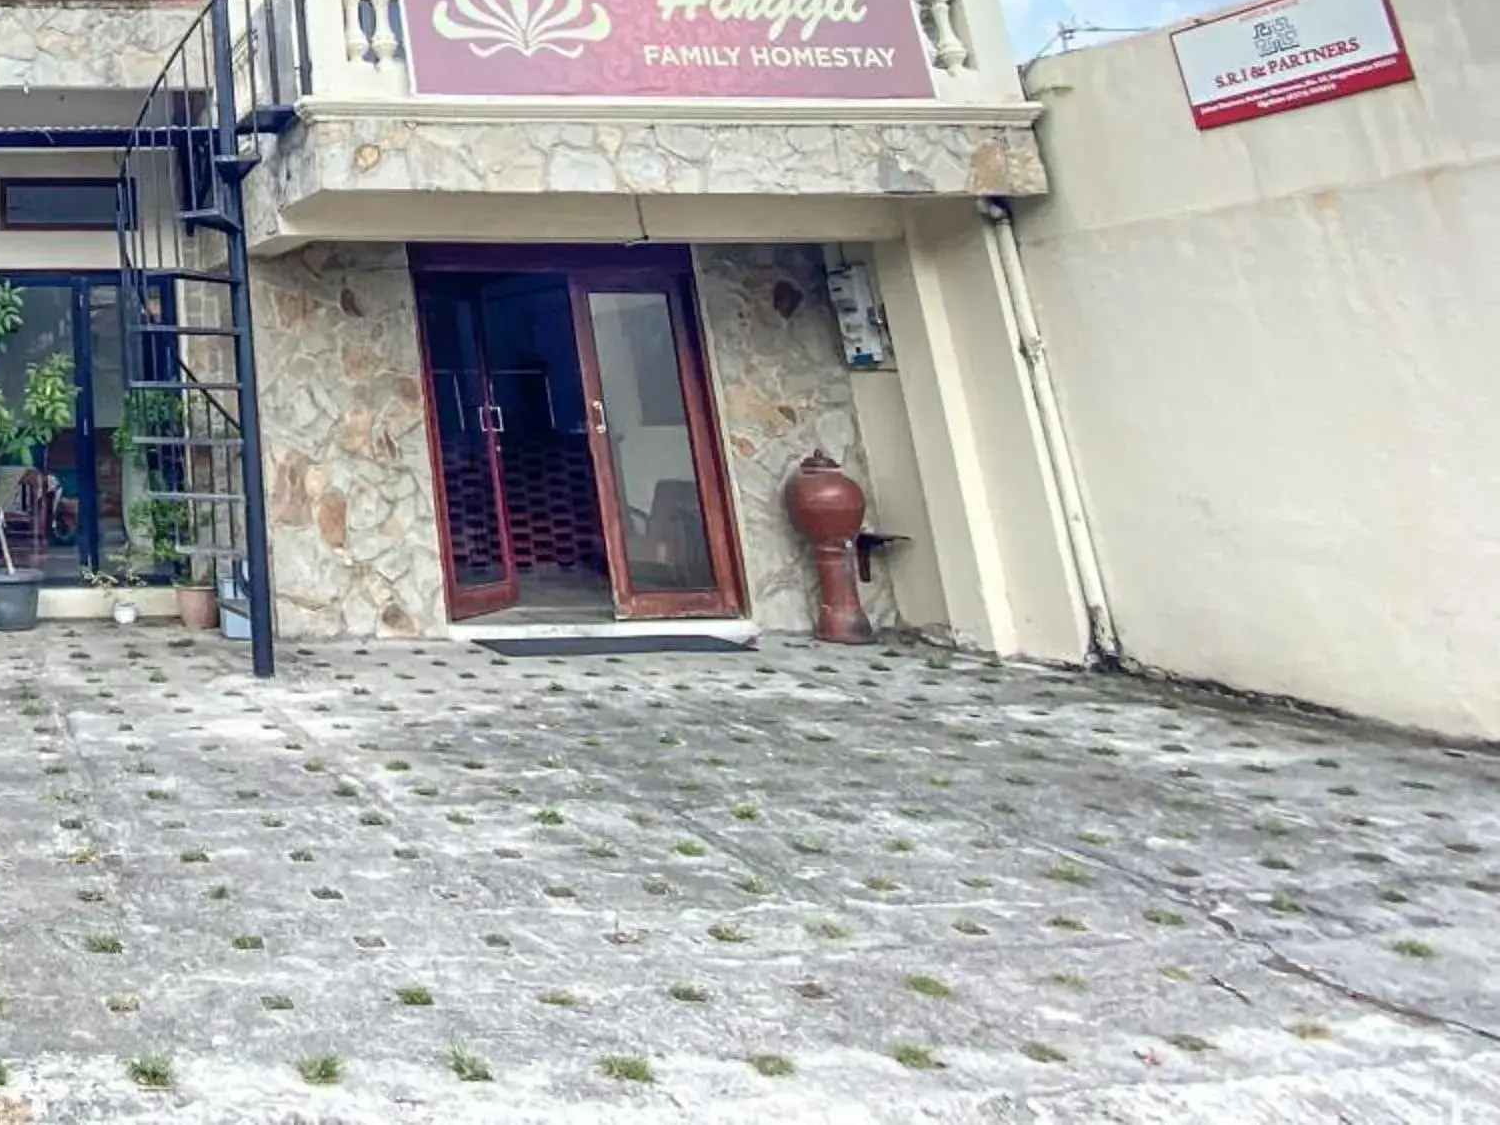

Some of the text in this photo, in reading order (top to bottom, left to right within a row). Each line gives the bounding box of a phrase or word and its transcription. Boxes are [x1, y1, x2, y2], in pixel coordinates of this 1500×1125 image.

[643, 45, 896, 68] FAMILY HOMESTAY
[1250, 65, 1267, 80] &
[1267, 37, 1360, 74] PARTNERS
